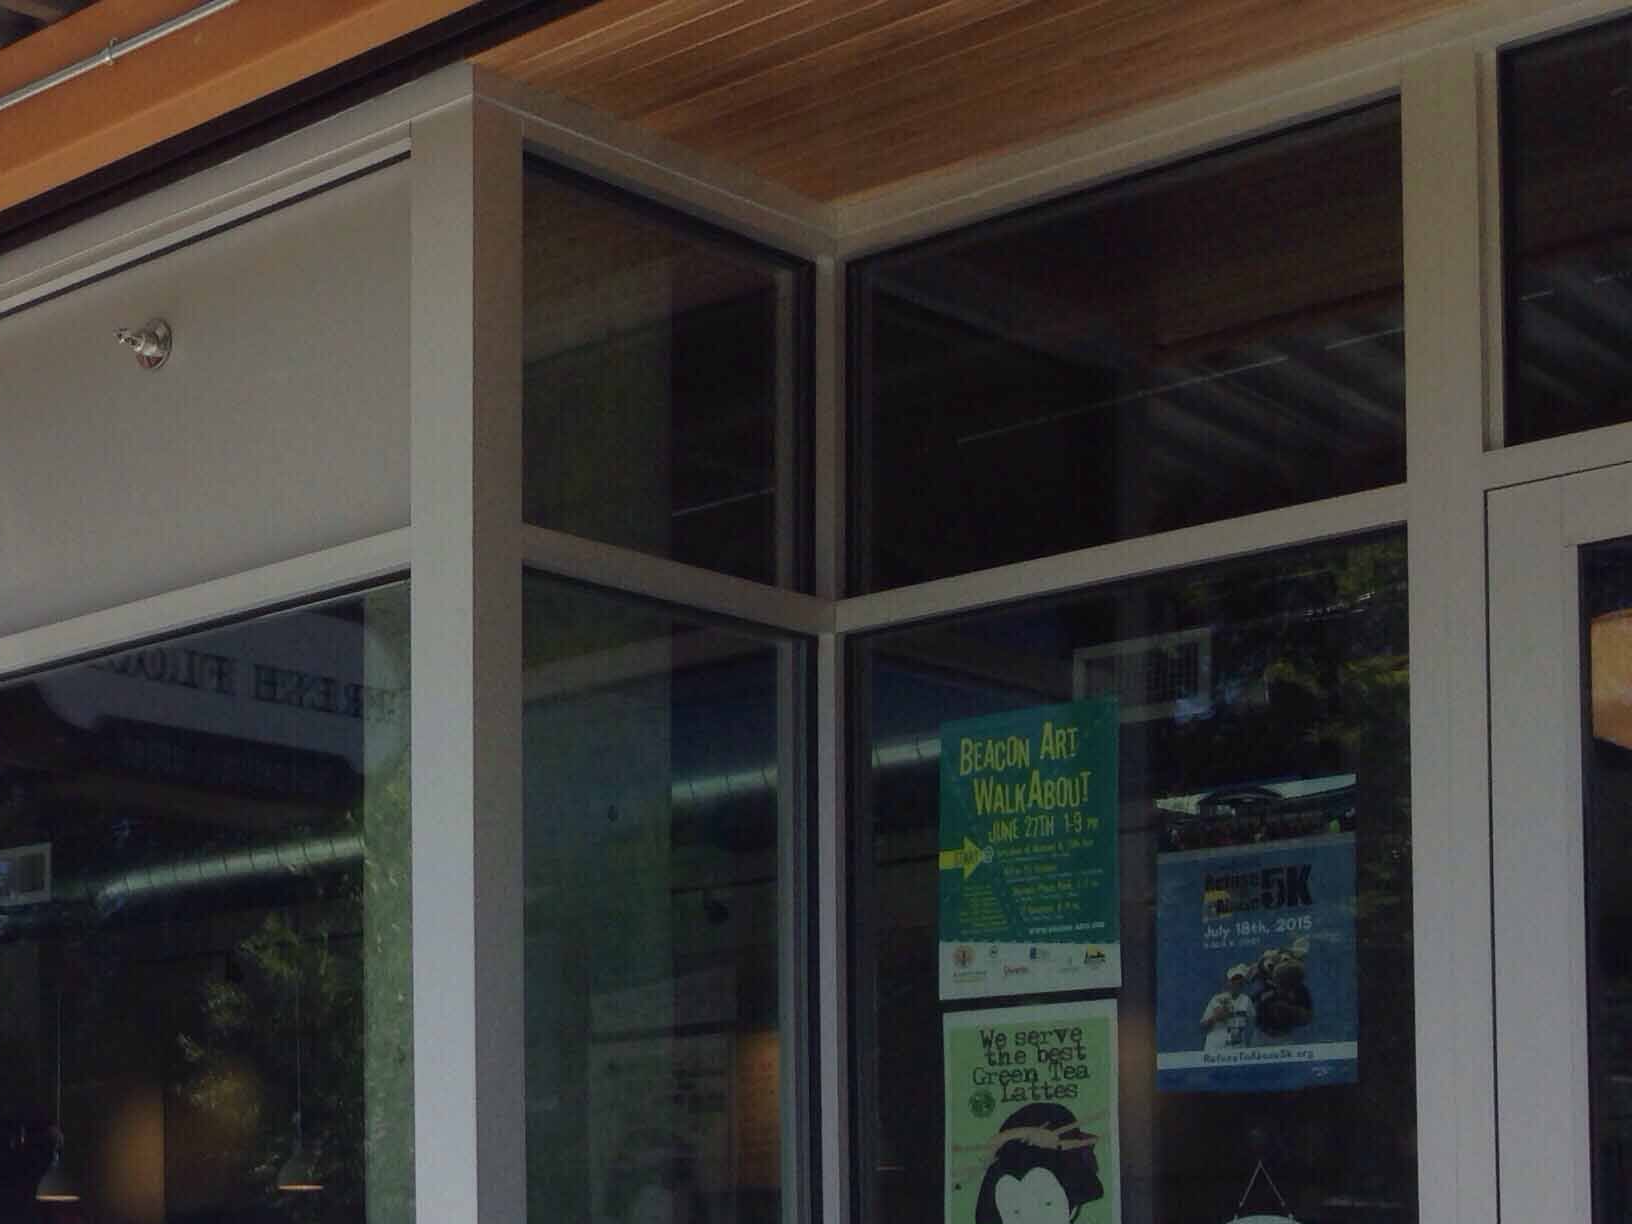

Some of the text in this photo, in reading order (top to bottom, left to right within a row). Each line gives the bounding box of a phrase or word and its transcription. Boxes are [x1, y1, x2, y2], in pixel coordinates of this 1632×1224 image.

[959, 720, 1079, 777] BEACON ART
[974, 768, 1092, 816] WALKABOUT
[988, 817, 1020, 842] JUNE
[1262, 864, 1312, 907] 5K
[1203, 915, 1313, 940] July 18th, 2015
[979, 1026, 1082, 1049] We serve
[984, 1040, 1087, 1067] the best
[972, 1061, 1090, 1085] Green Tea
